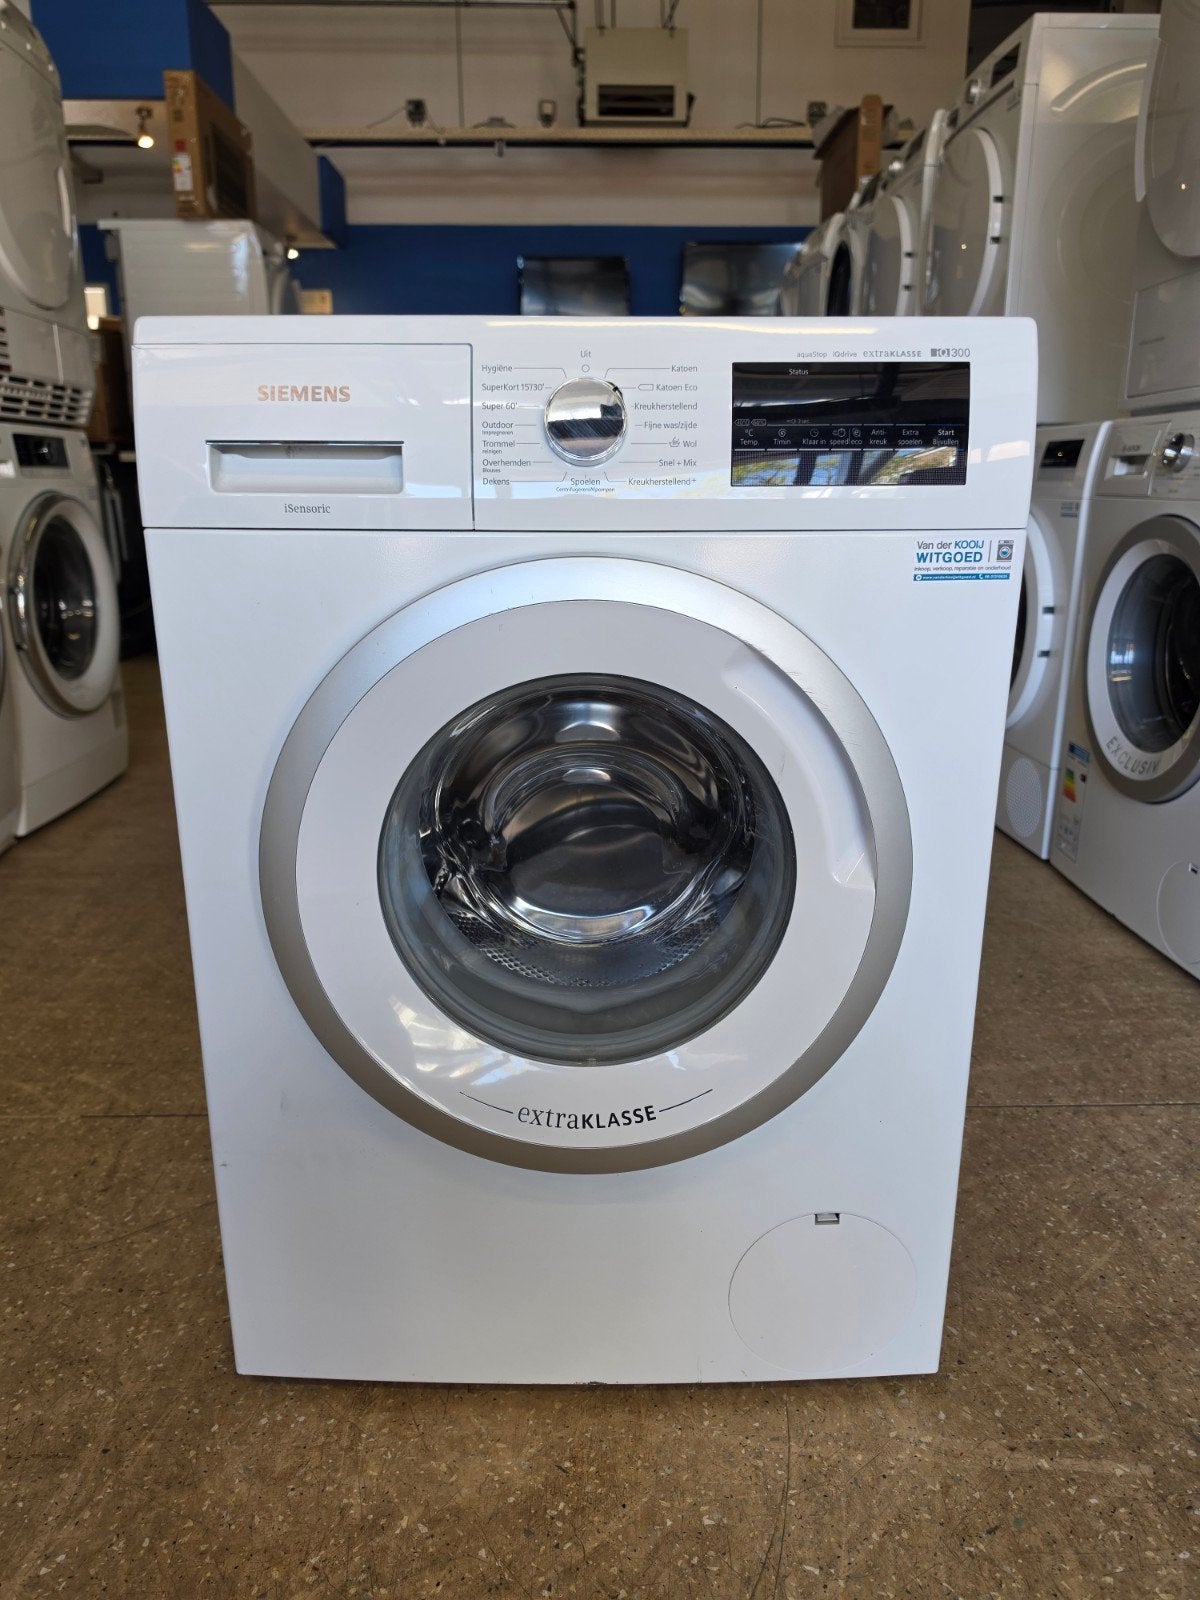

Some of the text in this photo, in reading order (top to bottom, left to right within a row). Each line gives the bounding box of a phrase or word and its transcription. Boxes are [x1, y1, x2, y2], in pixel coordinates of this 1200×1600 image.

[580, 350, 592, 359] Uit
[863, 348, 922, 358] extraKLASSE
[481, 364, 513, 374] Hygiëne
[671, 364, 698, 373] Katoen
[788, 368, 809, 376] Status
[481, 383, 519, 392] SuperKort
[656, 383, 698, 392] Katoen Eco
[257, 384, 351, 402] SIEMENS
[481, 402, 504, 411] Super
[634, 402, 698, 411] Kreukherstellend
[481, 421, 514, 429] Outdoor
[644, 421, 662, 431] Fijne
[871, 428, 887, 436] Anti-
[937, 428, 955, 436] Start
[482, 440, 516, 448] Trommel
[682, 440, 698, 448] Wol
[802, 438, 827, 446] Klaar in
[869, 438, 888, 446] kreuk
[898, 438, 923, 447] spoelen
[932, 438, 959, 447] Bijvullen
[482, 459, 532, 467] Overhemden
[658, 459, 676, 467] Snel
[683, 459, 697, 467] Mix
[482, 477, 510, 486] Dekens
[570, 477, 601, 487] Spoelen
[284, 503, 331, 514] iSensoric
[917, 540, 985, 550] Van der KOOIJ
[916, 551, 983, 563] WITGOED
[517, 1105, 657, 1130] extraKLASSE
